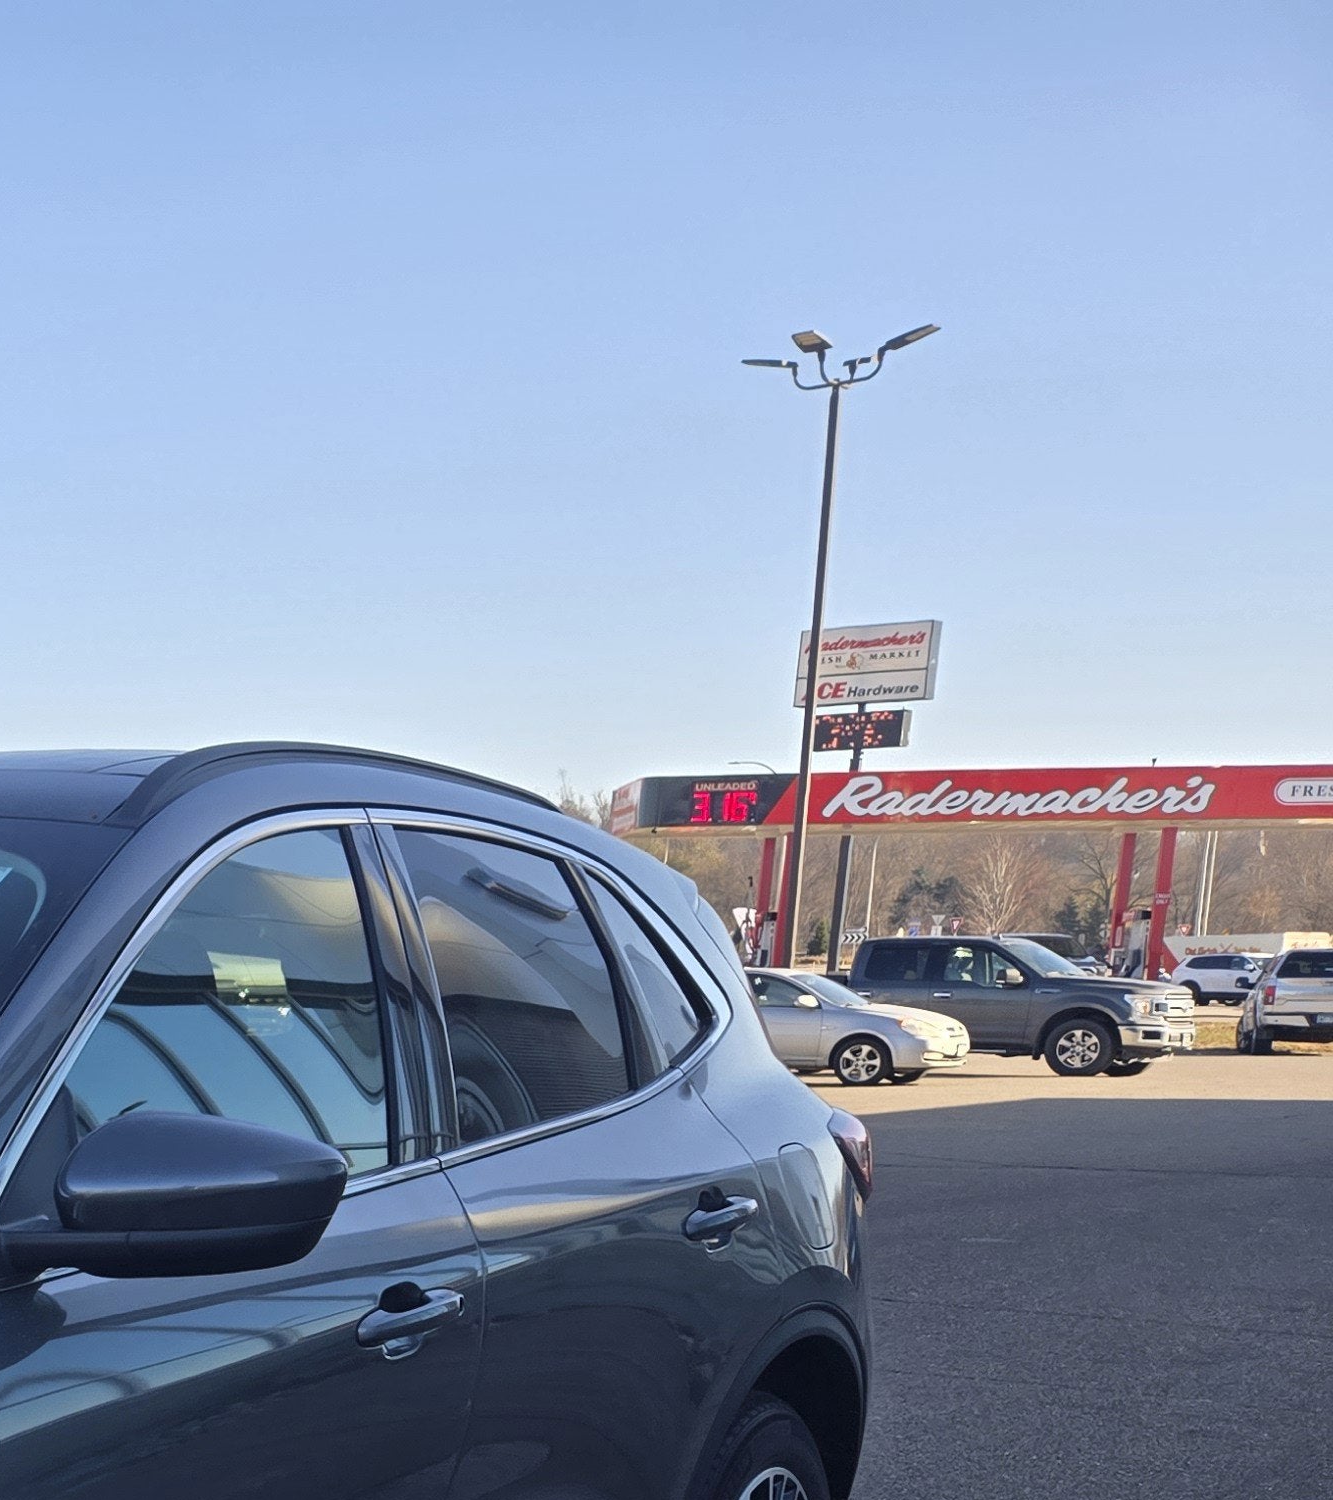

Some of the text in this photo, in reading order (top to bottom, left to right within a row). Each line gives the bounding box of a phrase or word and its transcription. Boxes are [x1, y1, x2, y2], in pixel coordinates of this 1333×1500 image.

[804, 631, 926, 653] adermacher's
[868, 650, 920, 660] MARKET
[846, 684, 919, 698] Hardware
[695, 781, 756, 791] UNLEADED
[822, 775, 1217, 819] Radermacher's
